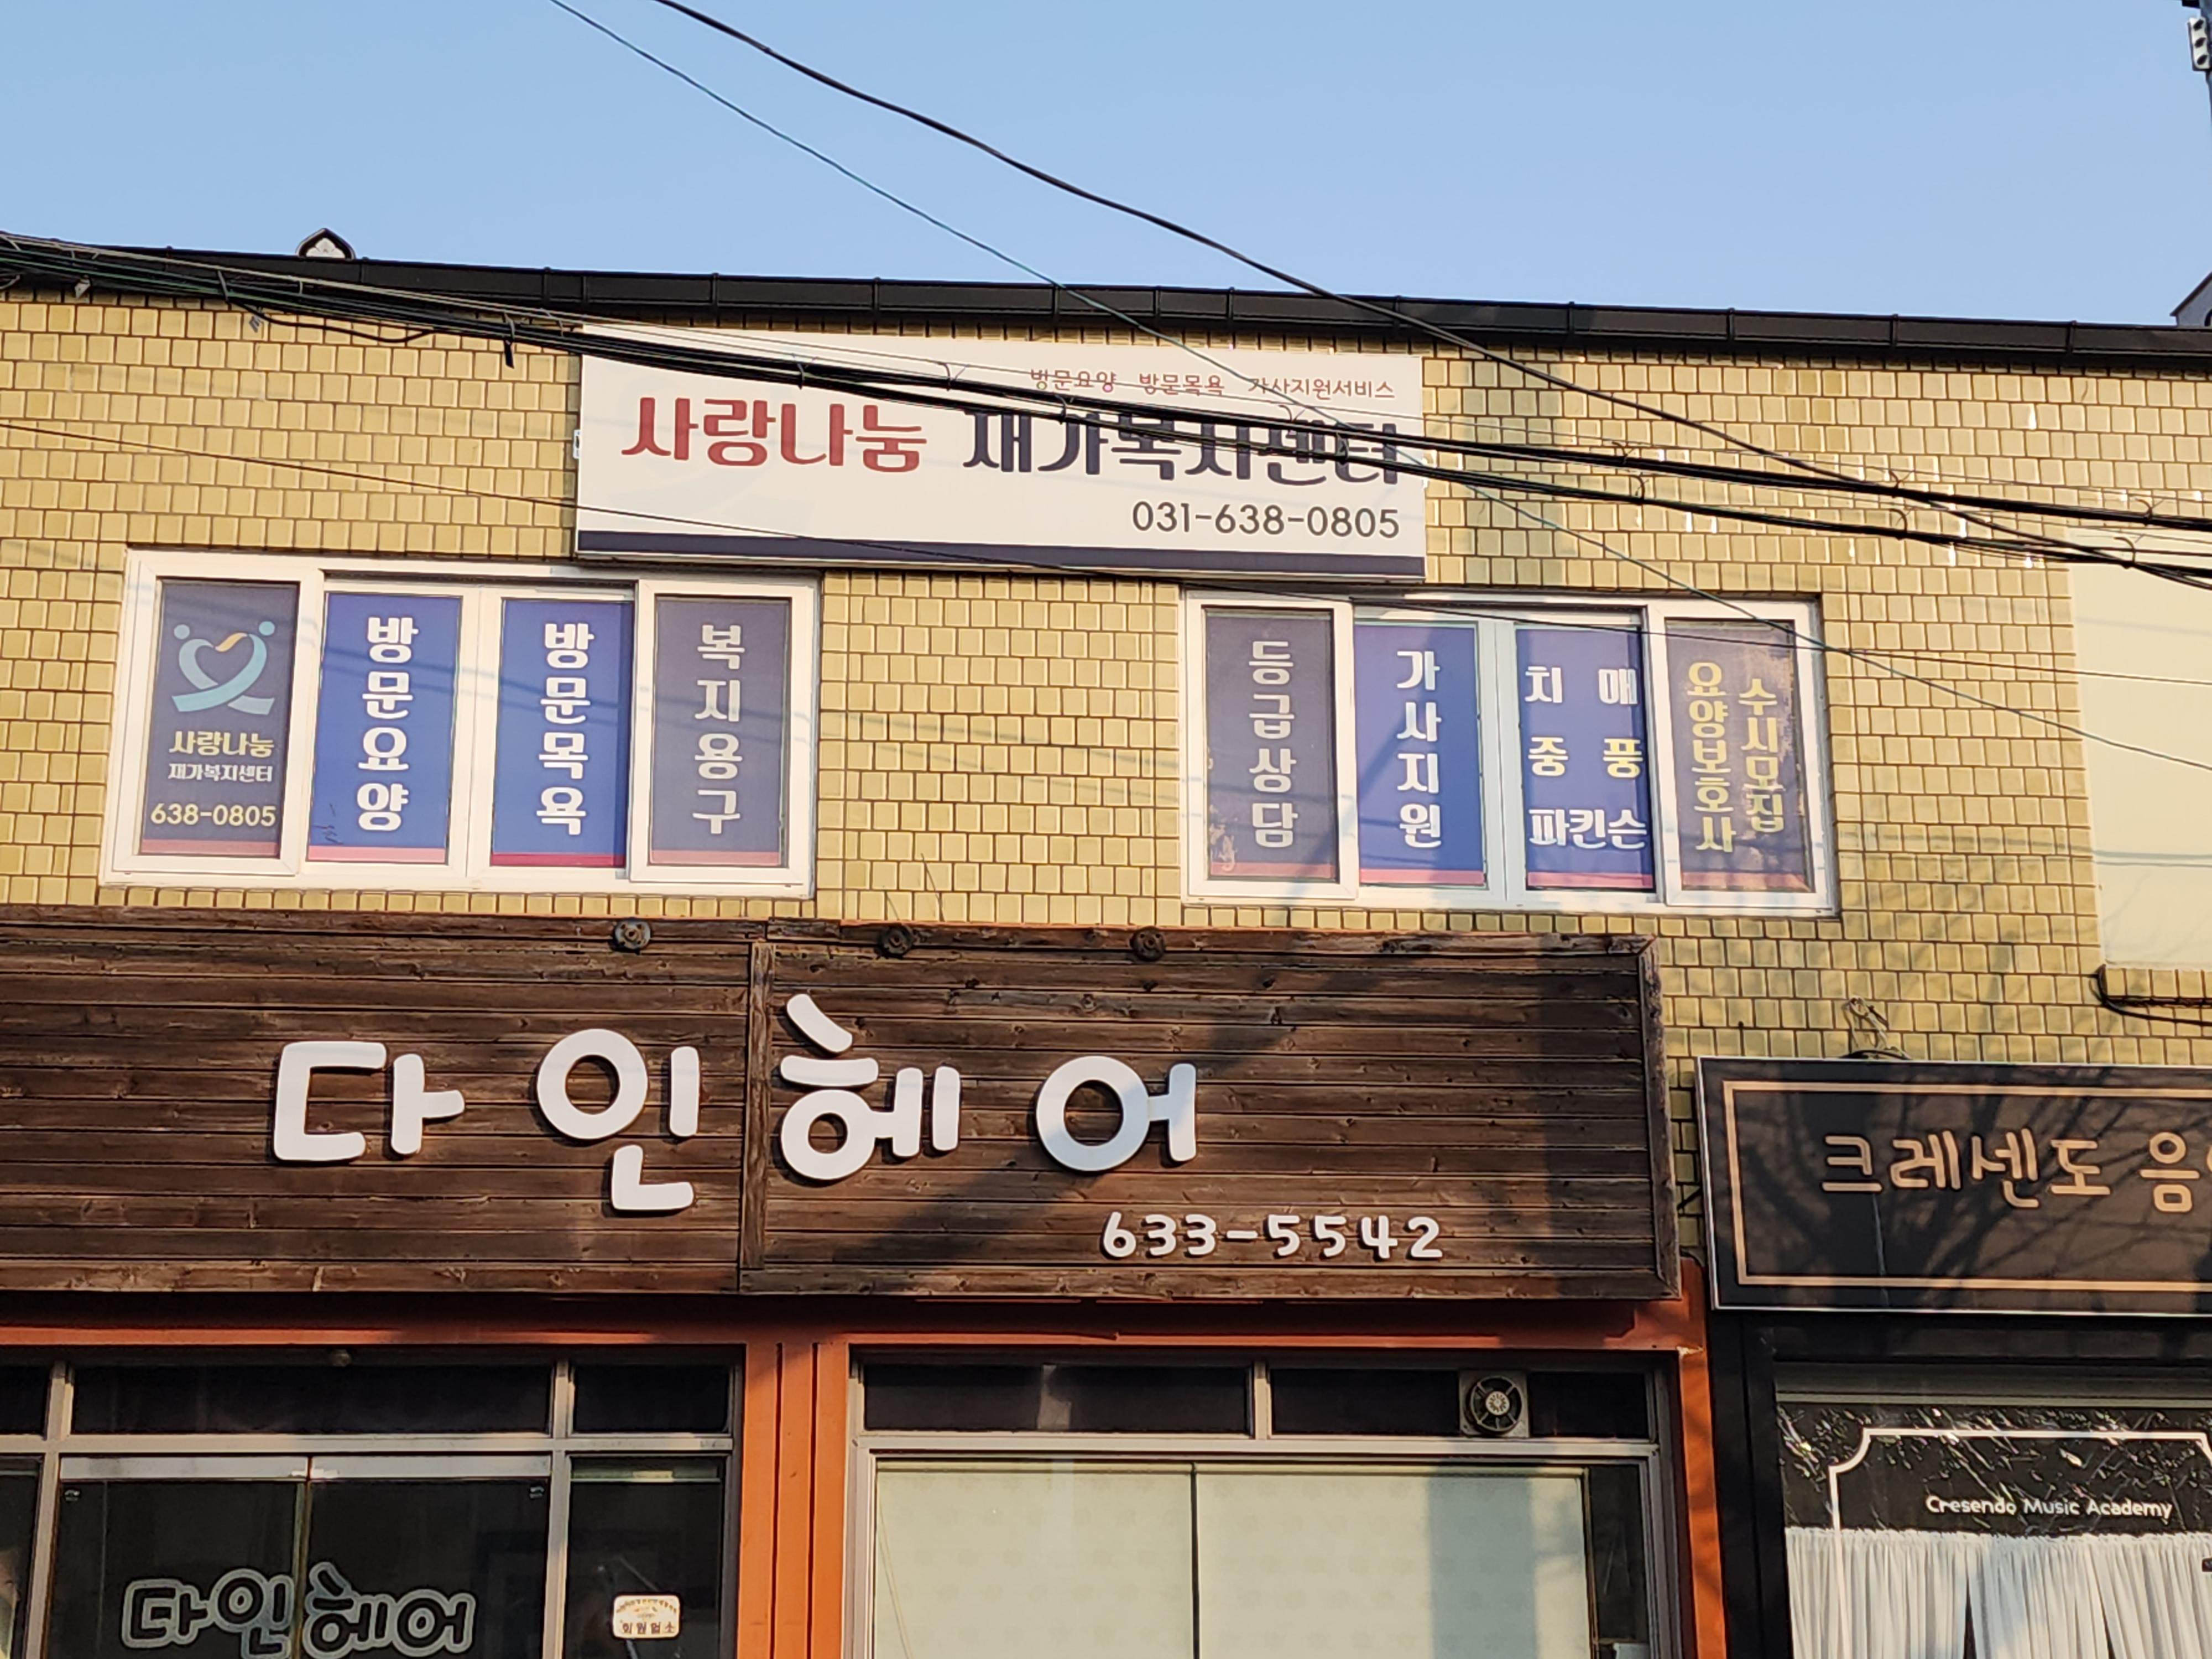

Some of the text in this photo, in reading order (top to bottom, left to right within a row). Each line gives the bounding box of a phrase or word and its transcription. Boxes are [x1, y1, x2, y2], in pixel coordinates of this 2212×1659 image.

[1030, 369, 1395, 400] 방문요양 방문목욕 가사지원서비스
[621, 397, 927, 473] 사랑나눔
[1133, 501, 1400, 539] 031-638-0805
[1525, 666, 1638, 705] 치매
[169, 730, 274, 758] 사랑나눔
[357, 617, 419, 832] 방문요양
[536, 622, 595, 836] 방문목욕
[692, 624, 745, 835] 복지용구
[1248, 640, 1298, 848] 등급상담
[168, 762, 273, 782] 재가복지센터
[1396, 650, 1442, 849] 가사지원
[1528, 736, 1644, 779] 중풍
[1687, 661, 1736, 853] 요양보호사
[1738, 678, 1786, 833] 수시모집
[150, 803, 276, 827] 638-0805
[1528, 808, 1647, 849] 파킨슨
[1822, 1128, 2212, 1212] 크레센도 음
[1102, 1212, 1443, 1260] 633-5542
[1926, 1495, 2173, 1523] Cresendo Music Academy
